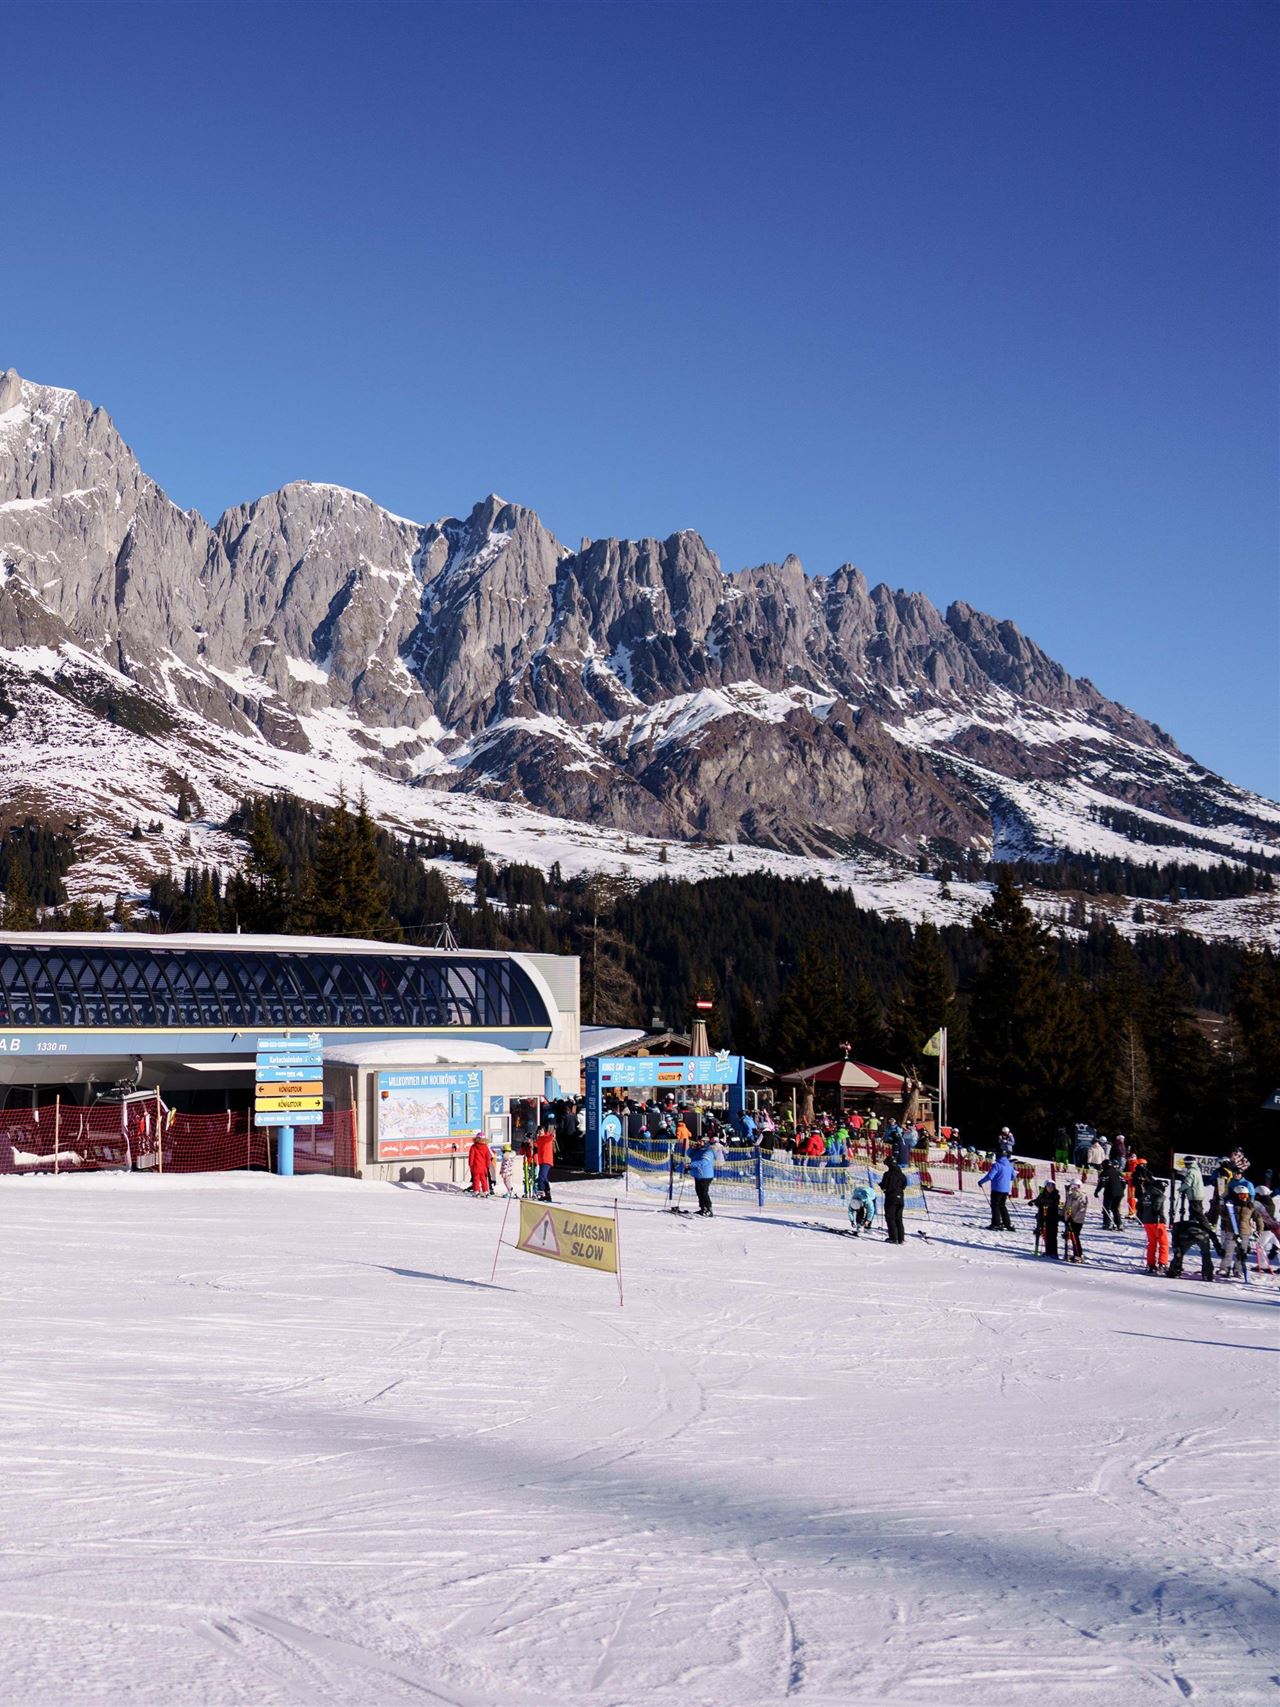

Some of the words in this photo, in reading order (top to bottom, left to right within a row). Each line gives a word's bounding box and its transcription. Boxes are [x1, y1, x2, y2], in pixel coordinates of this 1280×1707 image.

[37, 1042, 57, 1051] 1330
[58, 1043, 67, 1051] m
[562, 1220, 613, 1243] LANGSAM
[571, 1241, 604, 1261] SLOW
